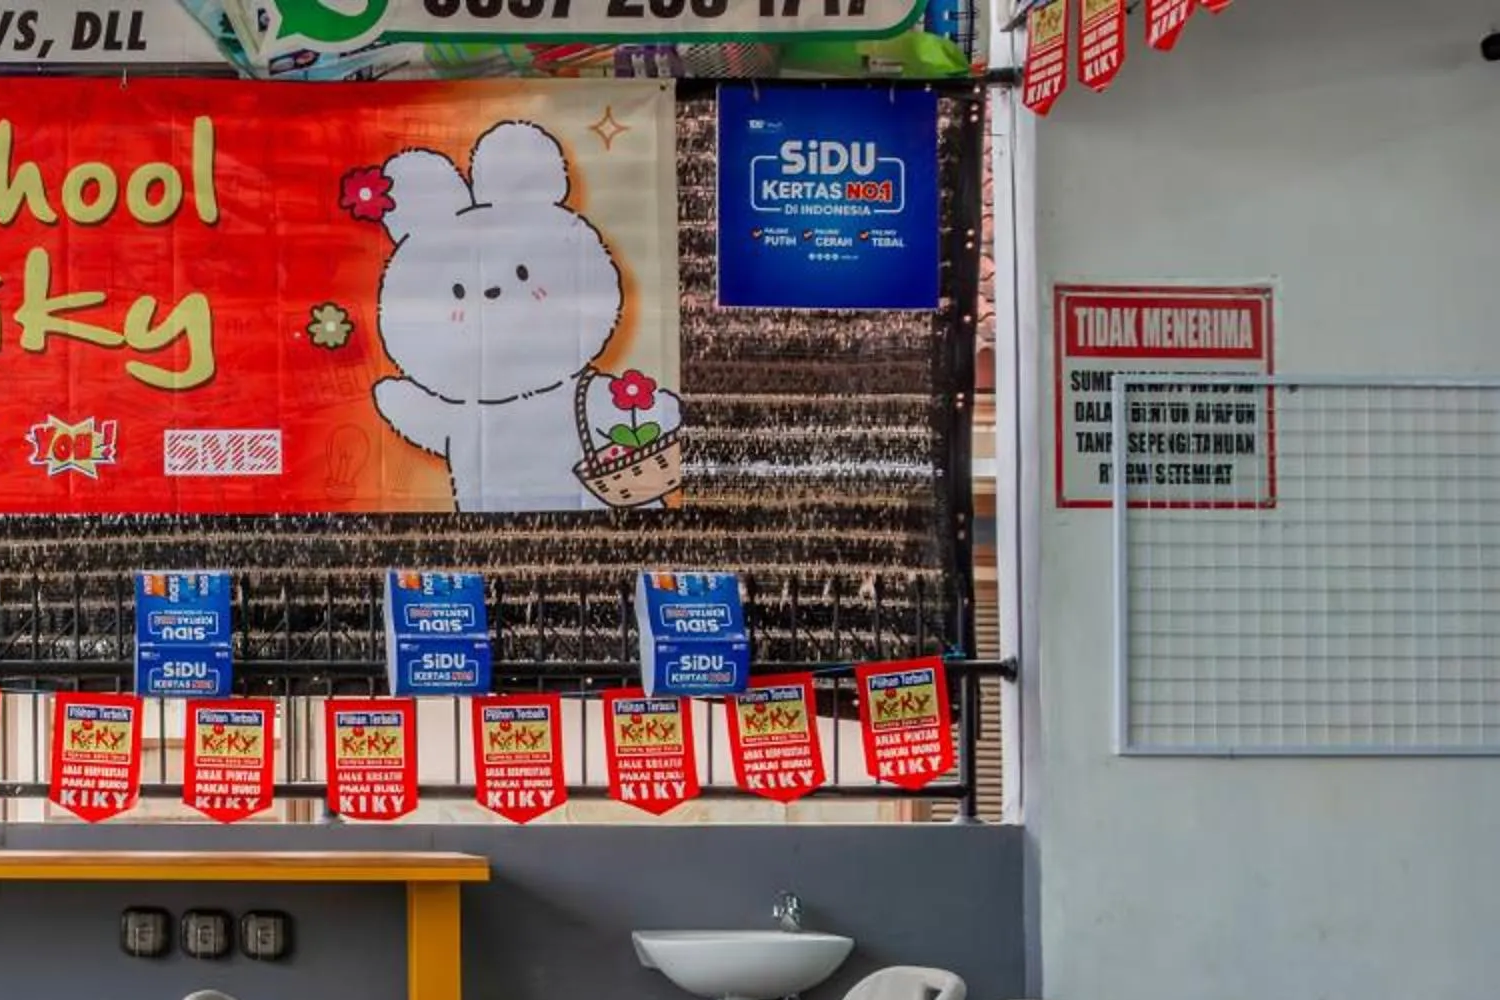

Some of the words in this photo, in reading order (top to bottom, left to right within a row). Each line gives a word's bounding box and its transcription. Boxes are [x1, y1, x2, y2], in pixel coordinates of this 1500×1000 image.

[71, 11, 147, 51] DLL
[762, 180, 841, 200] KERTAS
[785, 204, 798, 215] DI
[801, 204, 871, 215] INDONESIA
[764, 236, 796, 246] PUTIH
[1074, 307, 1138, 347] TIDAK
[1142, 308, 1253, 349] MENERIMA
[1075, 402, 1120, 422] DALA
[1076, 432, 1120, 452] TANP
[879, 754, 943, 778] KIKY
[746, 769, 815, 790] KIKY
[59, 790, 128, 809] KIKY
[487, 789, 555, 808] KIKY
[620, 781, 685, 800] KIKY
[195, 796, 260, 810] KIKY
[339, 795, 405, 813] KIKY
